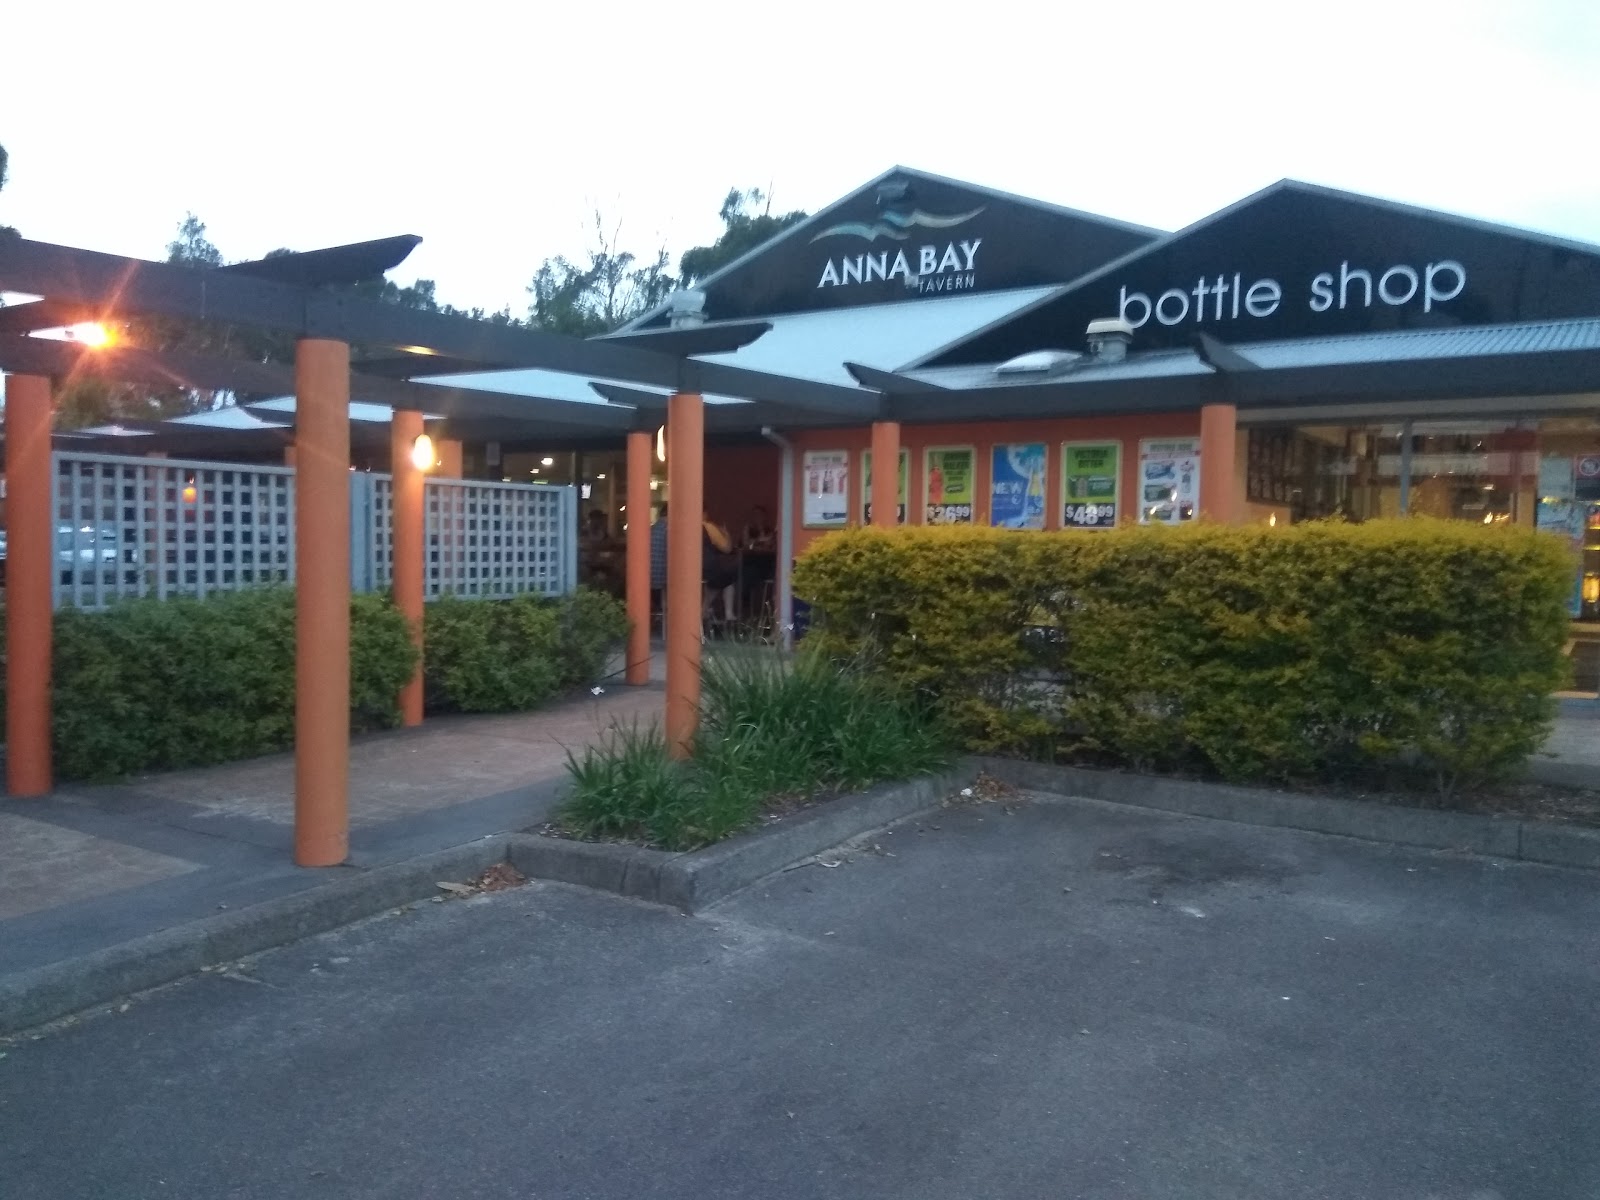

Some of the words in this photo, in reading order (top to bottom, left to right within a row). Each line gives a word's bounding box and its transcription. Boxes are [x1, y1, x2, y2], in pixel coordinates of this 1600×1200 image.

[817, 247, 910, 288] ANNA
[918, 238, 982, 276] BAY
[919, 273, 975, 293] TAVERN
[1118, 272, 1282, 329] bottle
[1308, 259, 1467, 313] shop
[993, 481, 1023, 494] NEW
